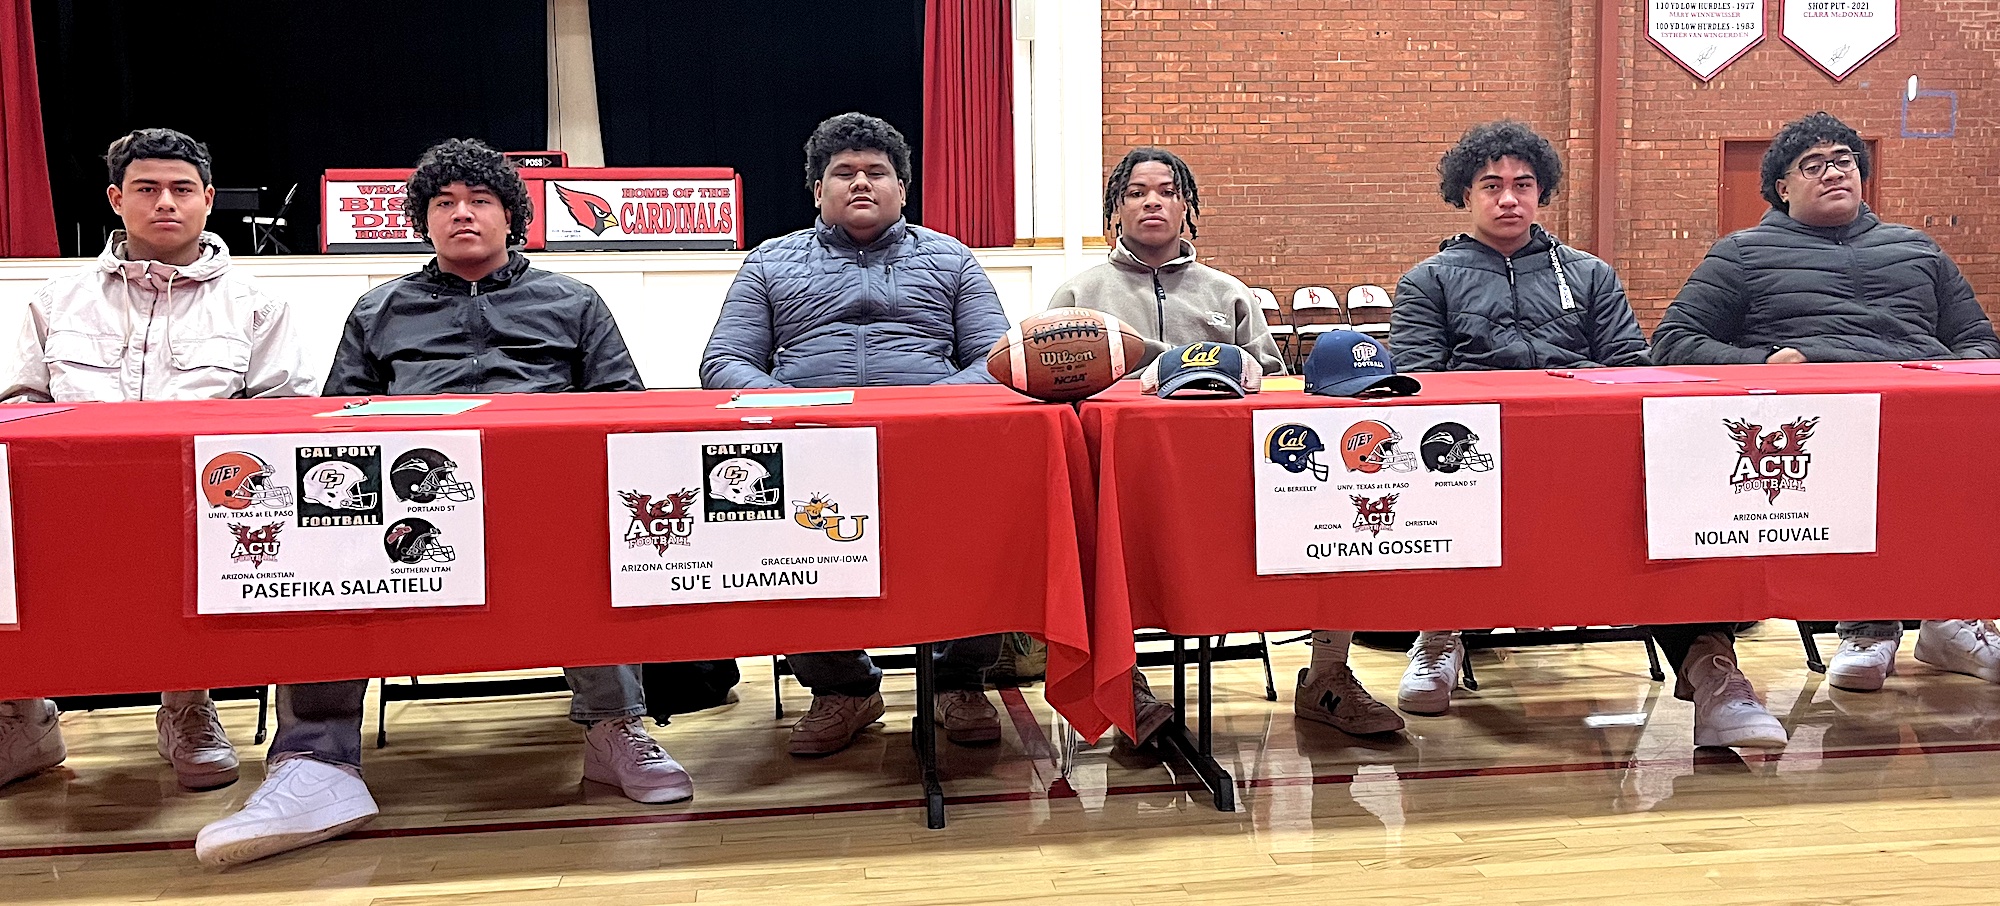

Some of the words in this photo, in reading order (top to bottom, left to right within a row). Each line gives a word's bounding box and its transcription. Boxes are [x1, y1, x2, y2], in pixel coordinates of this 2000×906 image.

[622, 188, 669, 198] HOME
[673, 188, 694, 198] OF
[698, 188, 730, 198] THE
[620, 202, 732, 234] CARDINALS
[356, 230, 408, 239] HIGH
[1040, 350, 1095, 366] Wilson
[1181, 342, 1221, 369] Cal
[1053, 373, 1087, 385] NCAA
[1278, 428, 1308, 451] Cal
[1347, 432, 1374, 451] UTEP
[300, 447, 333, 458] CAL
[340, 446, 377, 457] POLY
[706, 445, 737, 456] CAL
[740, 444, 779, 455] POLY
[209, 465, 240, 485] UTEP
[1730, 453, 1810, 485] ACU
[1734, 477, 1806, 494] FOOTBALL
[301, 515, 379, 527] FOOTBALL
[709, 510, 781, 522] FOOTBALL
[1353, 511, 1395, 528] ACU
[1769, 512, 1809, 520] CHRISTIAN
[624, 516, 694, 540] ACU
[1695, 530, 1749, 546] NOLAN
[1758, 527, 1830, 542] FOUVALE
[230, 540, 280, 559] ACU
[628, 536, 691, 549] FOOTBALL
[1306, 541, 1373, 559] QU'RAN
[1378, 539, 1452, 555] GOSSETT
[621, 562, 663, 572] ARIZONA
[665, 561, 713, 570] CHRISTIAN
[761, 556, 815, 566] GRACELAND
[817, 555, 869, 564] UNIV-IOWA
[242, 581, 335, 599] PASEFIKA
[340, 577, 443, 595] SALATIELU
[671, 575, 712, 591] SU'E
[723, 570, 819, 588] LUAMANU
